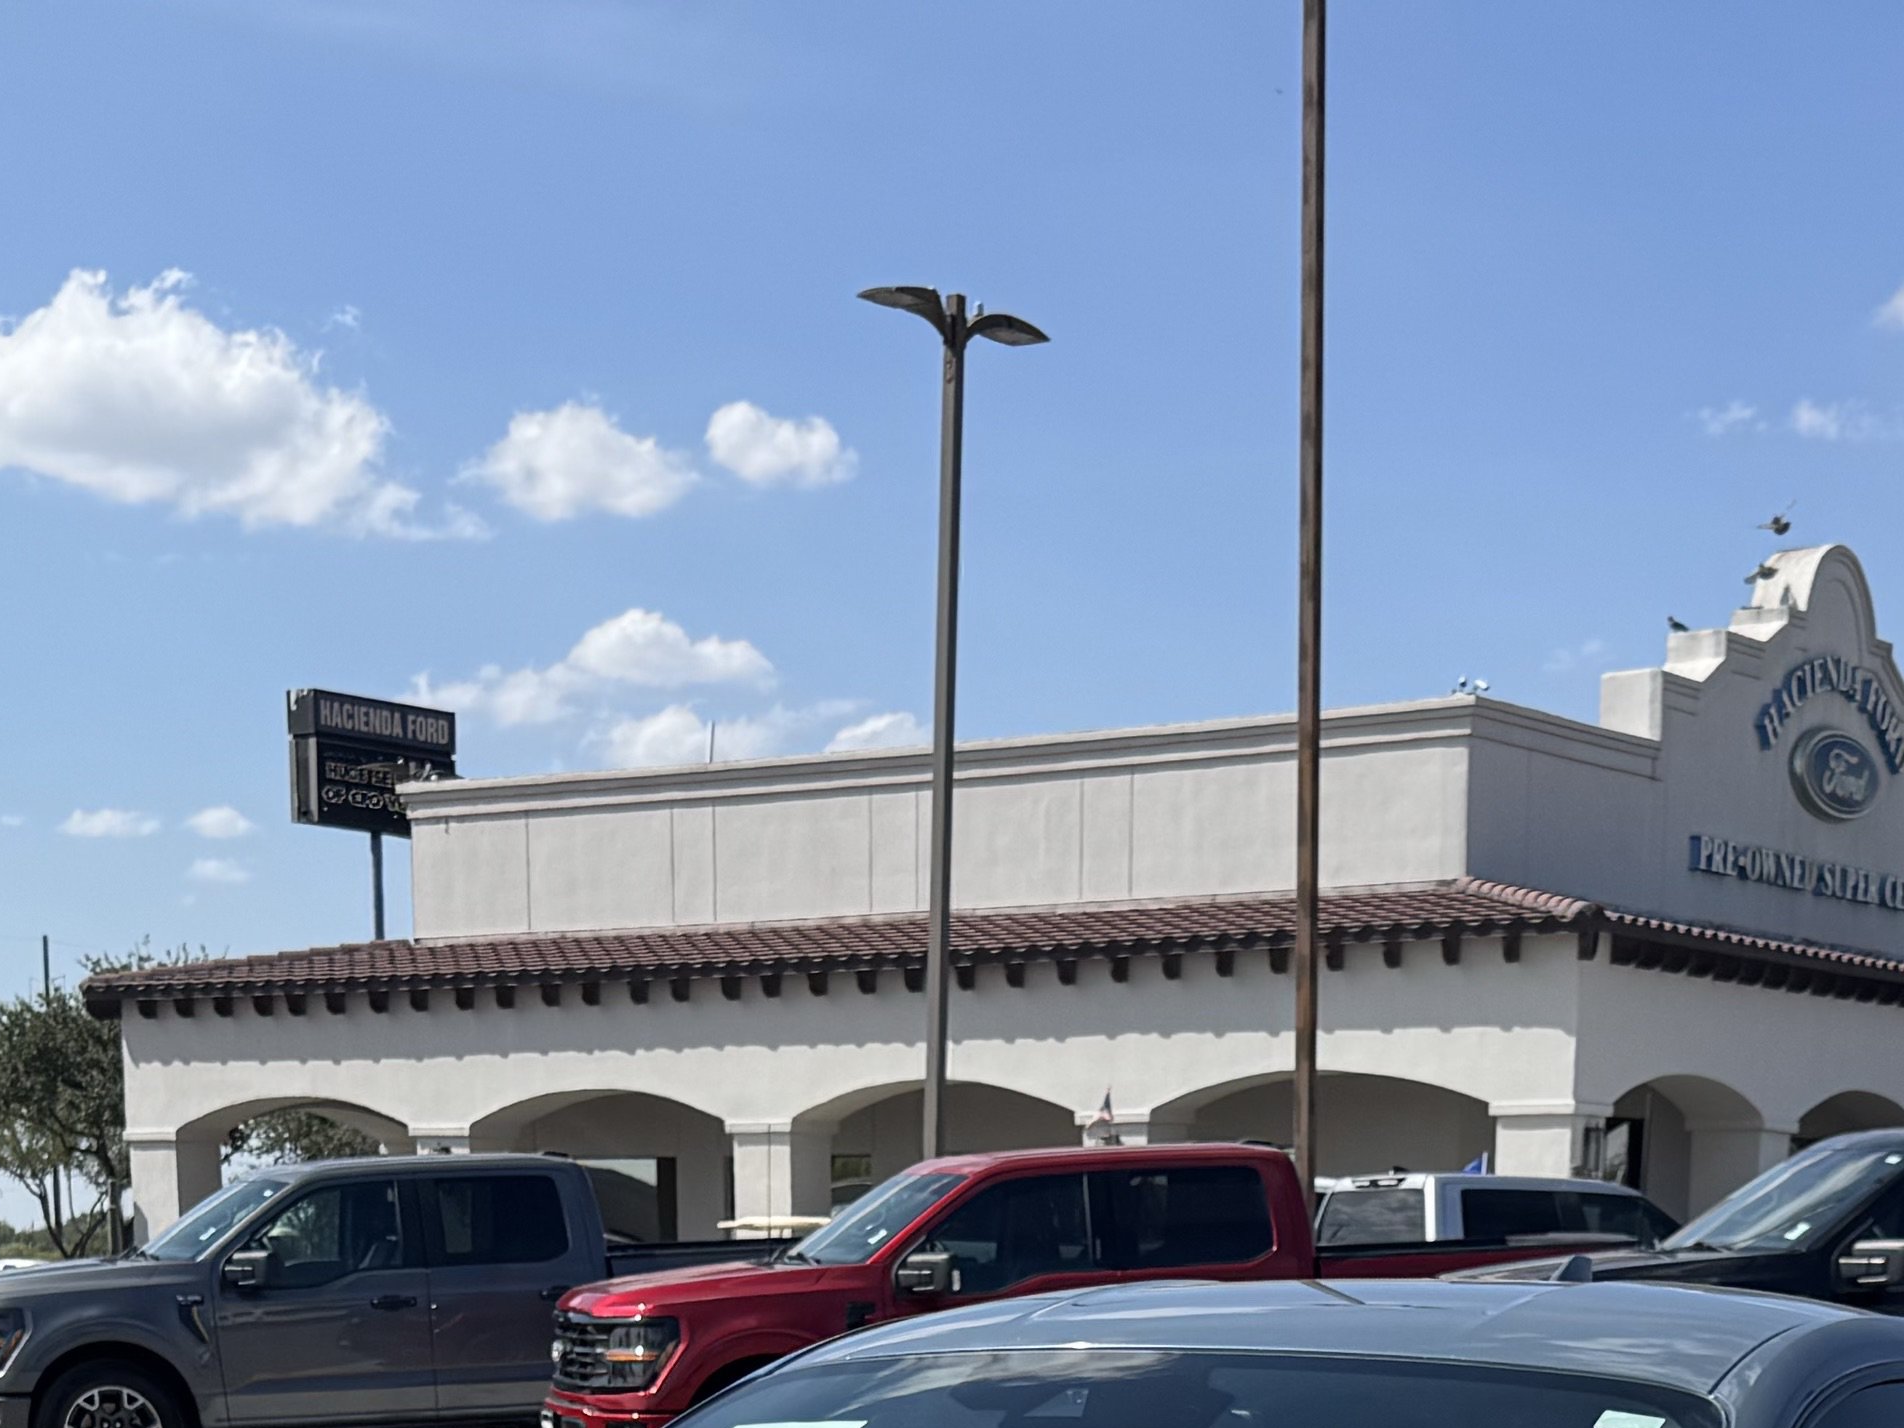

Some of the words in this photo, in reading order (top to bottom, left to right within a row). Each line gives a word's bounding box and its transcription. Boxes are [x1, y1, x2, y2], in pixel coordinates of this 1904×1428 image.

[319, 698, 403, 739] HACIENDA
[406, 714, 450, 745] FORD
[1693, 836, 1817, 892] PRE-OWNED
[1820, 862, 1880, 905] SUPER
